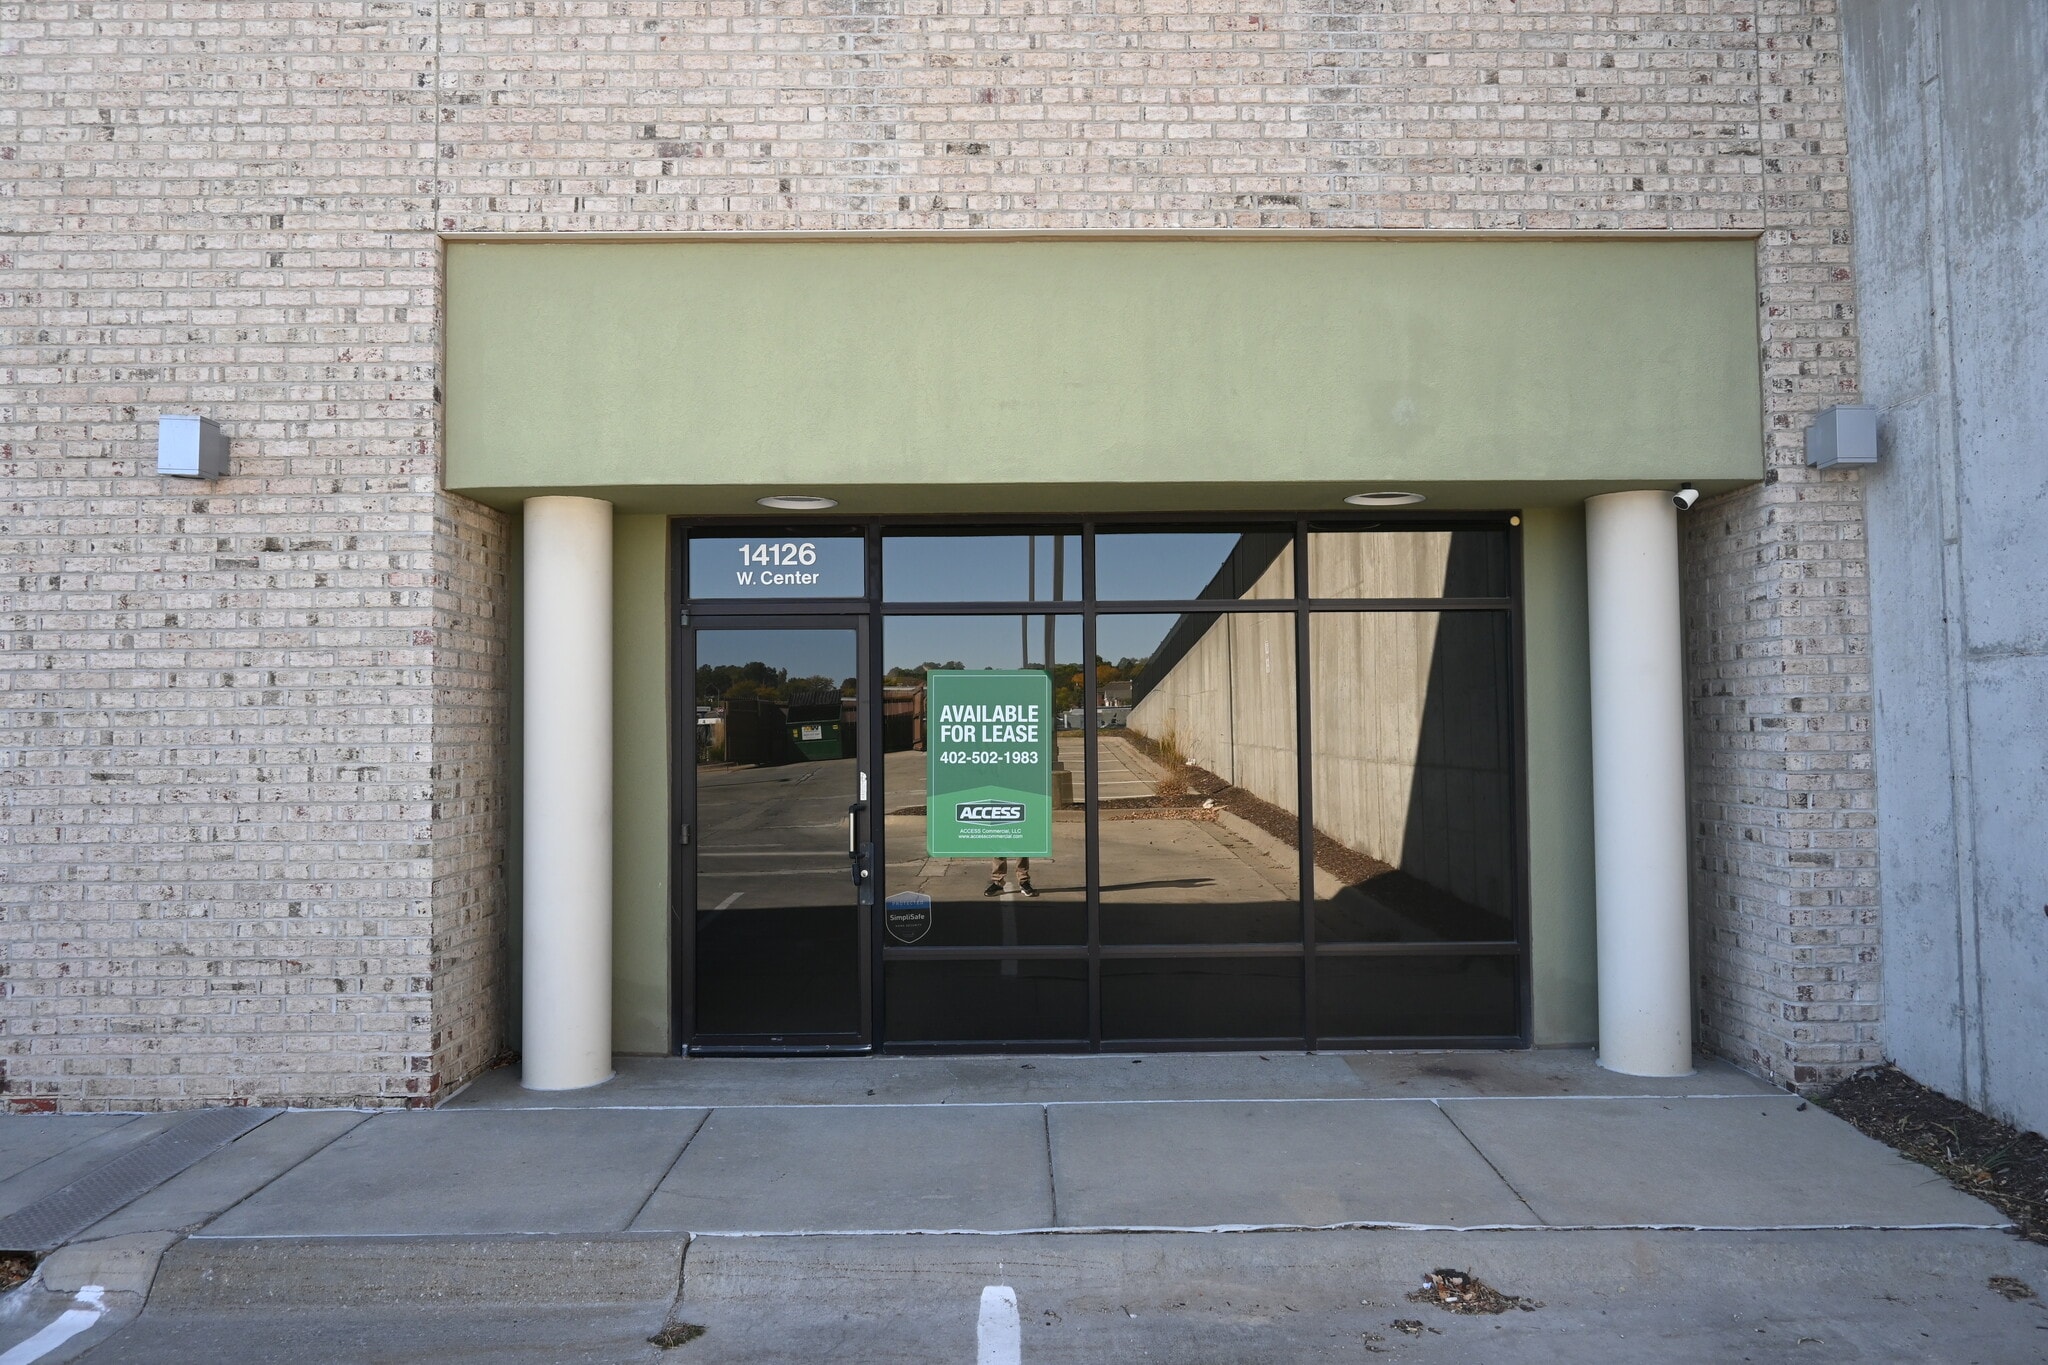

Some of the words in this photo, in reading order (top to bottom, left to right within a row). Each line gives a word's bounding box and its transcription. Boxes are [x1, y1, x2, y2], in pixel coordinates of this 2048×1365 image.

[739, 543, 816, 566] 14126
[736, 571, 756, 585] W.
[761, 571, 819, 585] Center
[940, 705, 1039, 722] AVAILABLE
[941, 725, 976, 742] FOR
[982, 725, 1039, 742] LEASE
[940, 751, 1039, 764] 402-502-1983
[960, 806, 1021, 819] ACCESS
[889, 913, 925, 922] SimpliSafe
